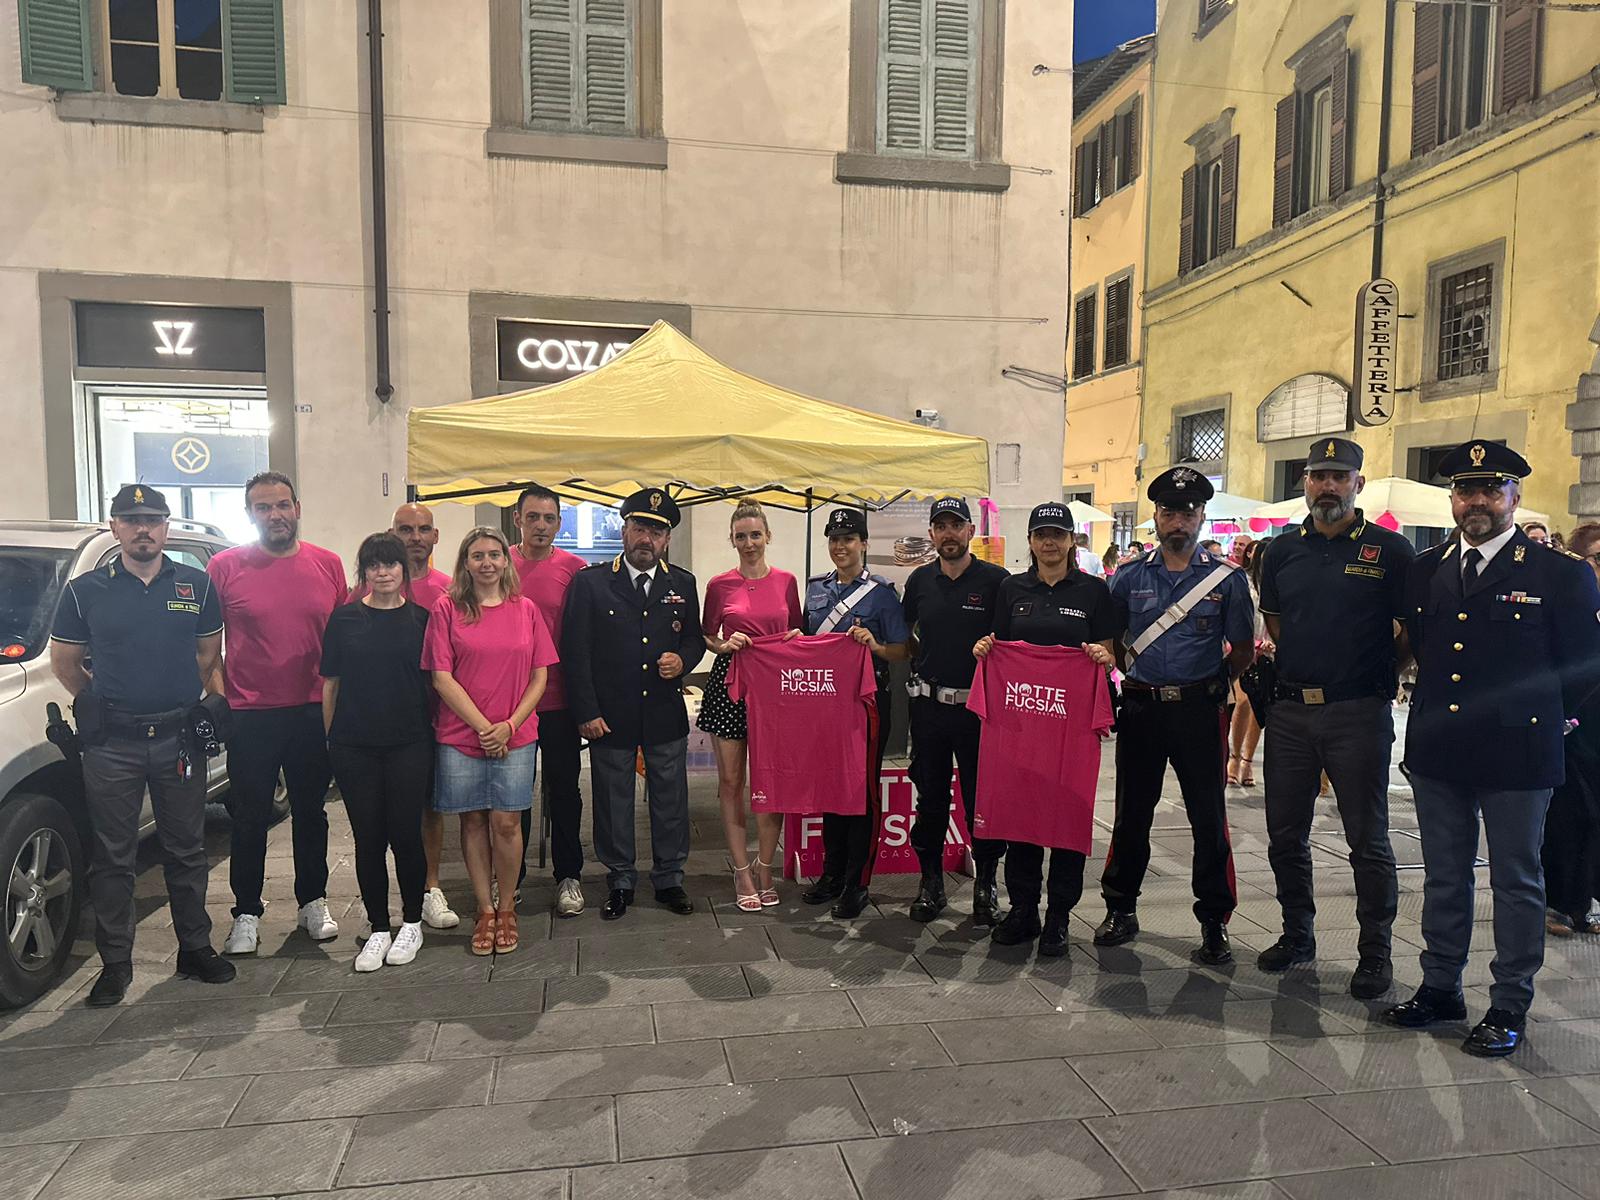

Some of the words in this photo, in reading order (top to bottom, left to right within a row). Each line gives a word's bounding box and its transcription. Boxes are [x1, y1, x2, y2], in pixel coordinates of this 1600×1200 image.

[1365, 283, 1394, 418] CAFFETTERIA
[781, 669, 833, 681] NOTTE
[781, 681, 836, 692] FUCSIA
[1007, 681, 1066, 702] NOTTE
[1005, 694, 1067, 715] FUCSIA
